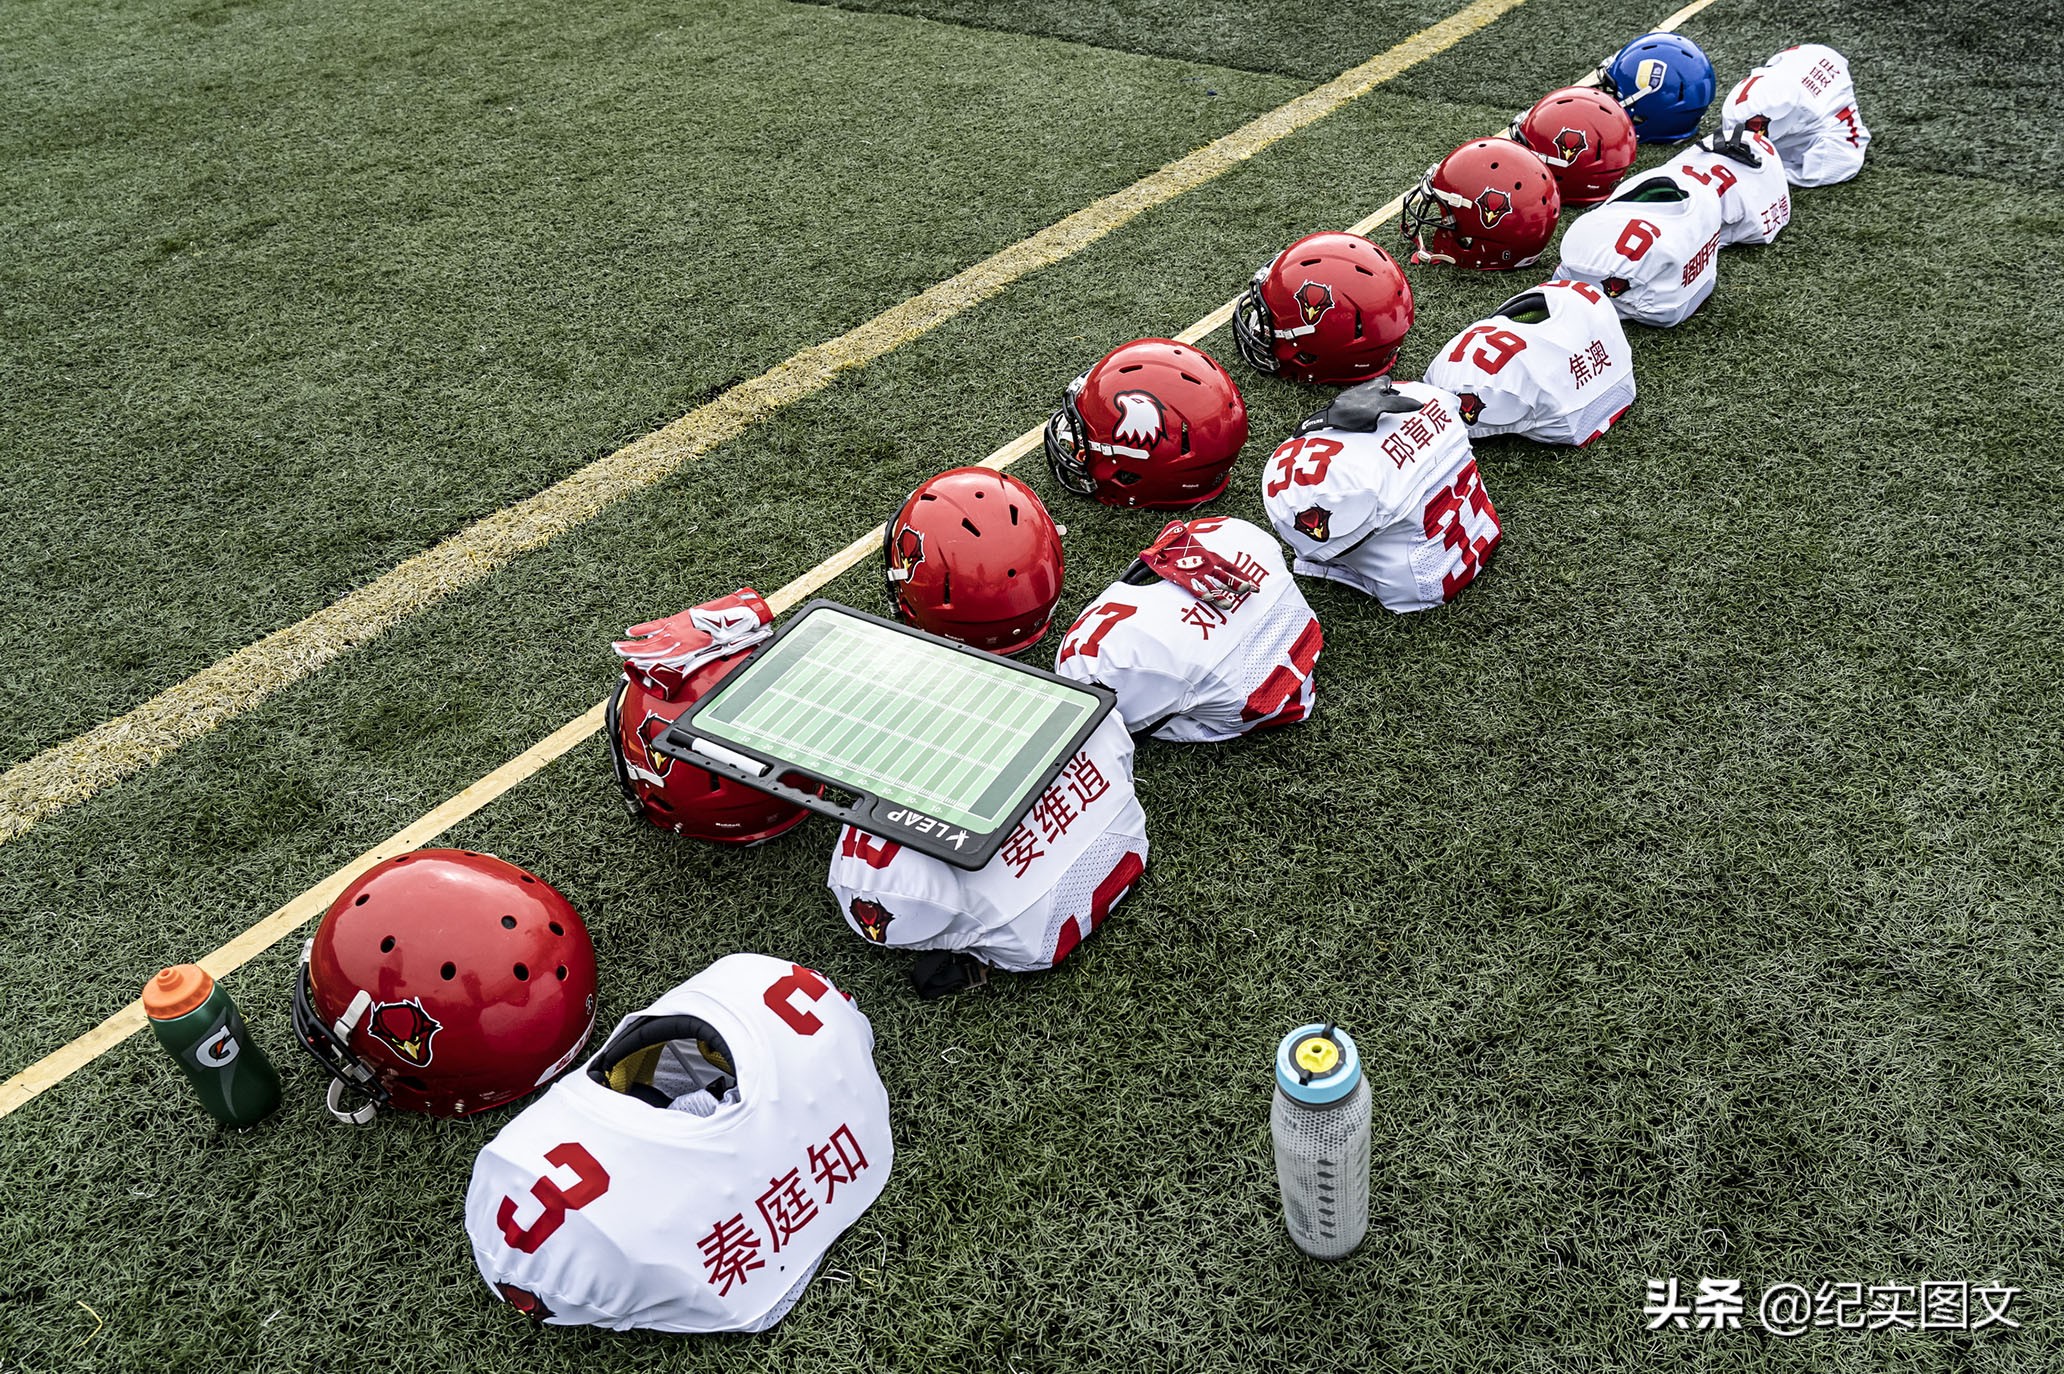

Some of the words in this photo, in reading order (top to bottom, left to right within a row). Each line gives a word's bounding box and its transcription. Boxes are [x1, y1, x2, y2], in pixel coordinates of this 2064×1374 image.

[1614, 218, 1662, 262] 6
[1448, 326, 1527, 376] 79
[1568, 339, 1612, 390] 焦澳
[1380, 398, 1453, 470] 邱章宸
[1267, 437, 1345, 498] 33
[887, 809, 951, 838] LEAP
[1000, 751, 1111, 879] 晏维逍
[195, 1025, 241, 1068] G
[497, 1142, 611, 1254] 3
[696, 1123, 869, 1297] 秦庭知
